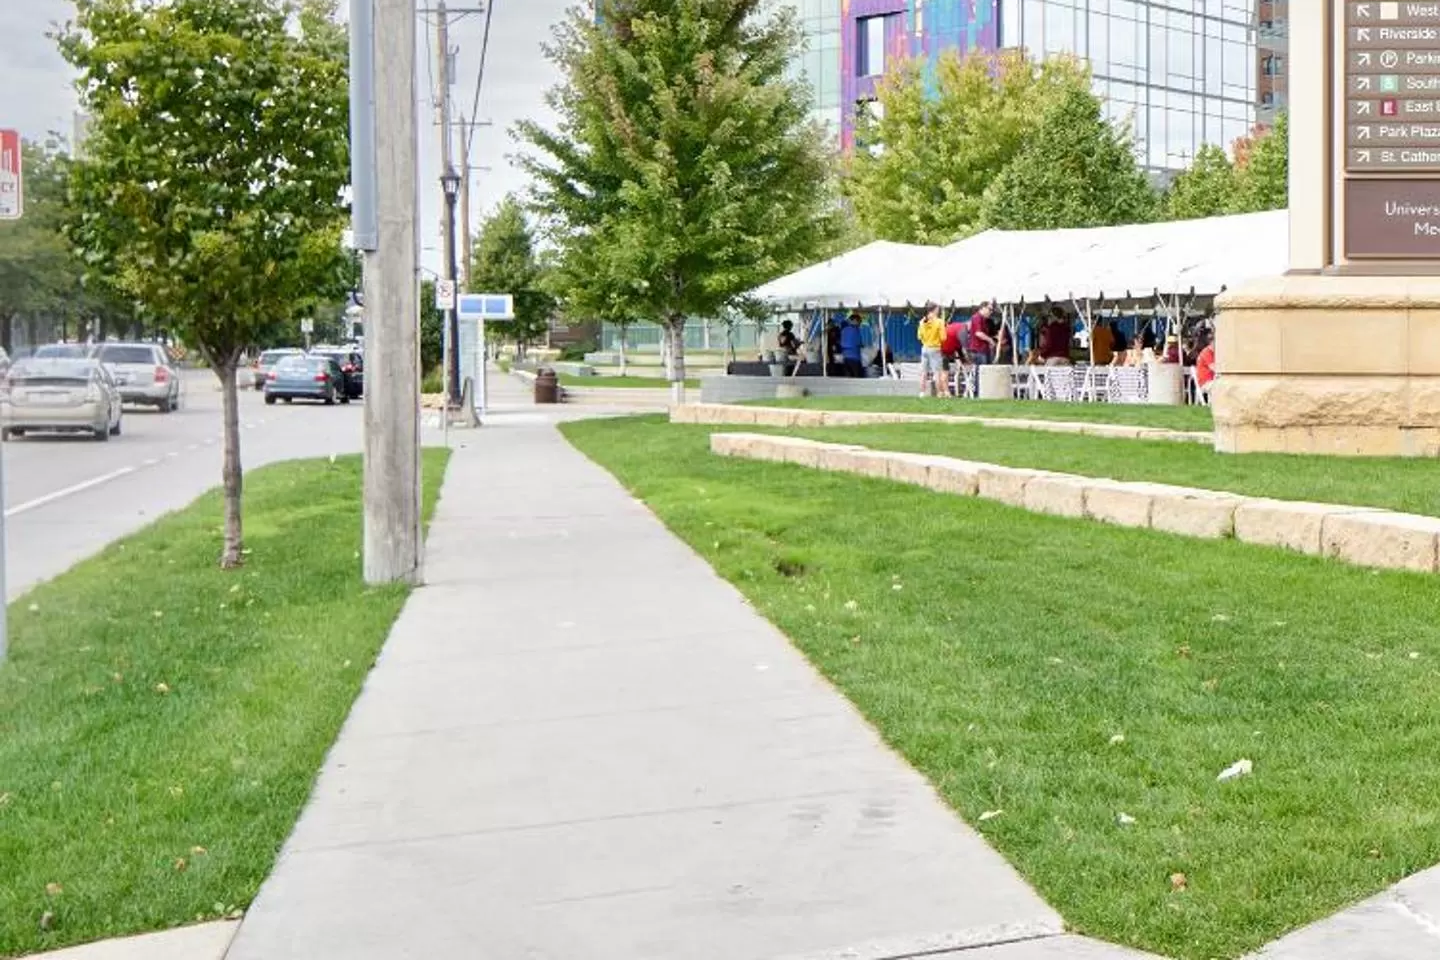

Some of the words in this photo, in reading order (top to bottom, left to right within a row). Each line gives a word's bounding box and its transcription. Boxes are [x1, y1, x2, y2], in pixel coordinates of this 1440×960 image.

[1379, 28, 1437, 39] Riverside
[1405, 101, 1433, 112] East
[1379, 126, 1406, 137] Park
[1381, 151, 1397, 162] St.
